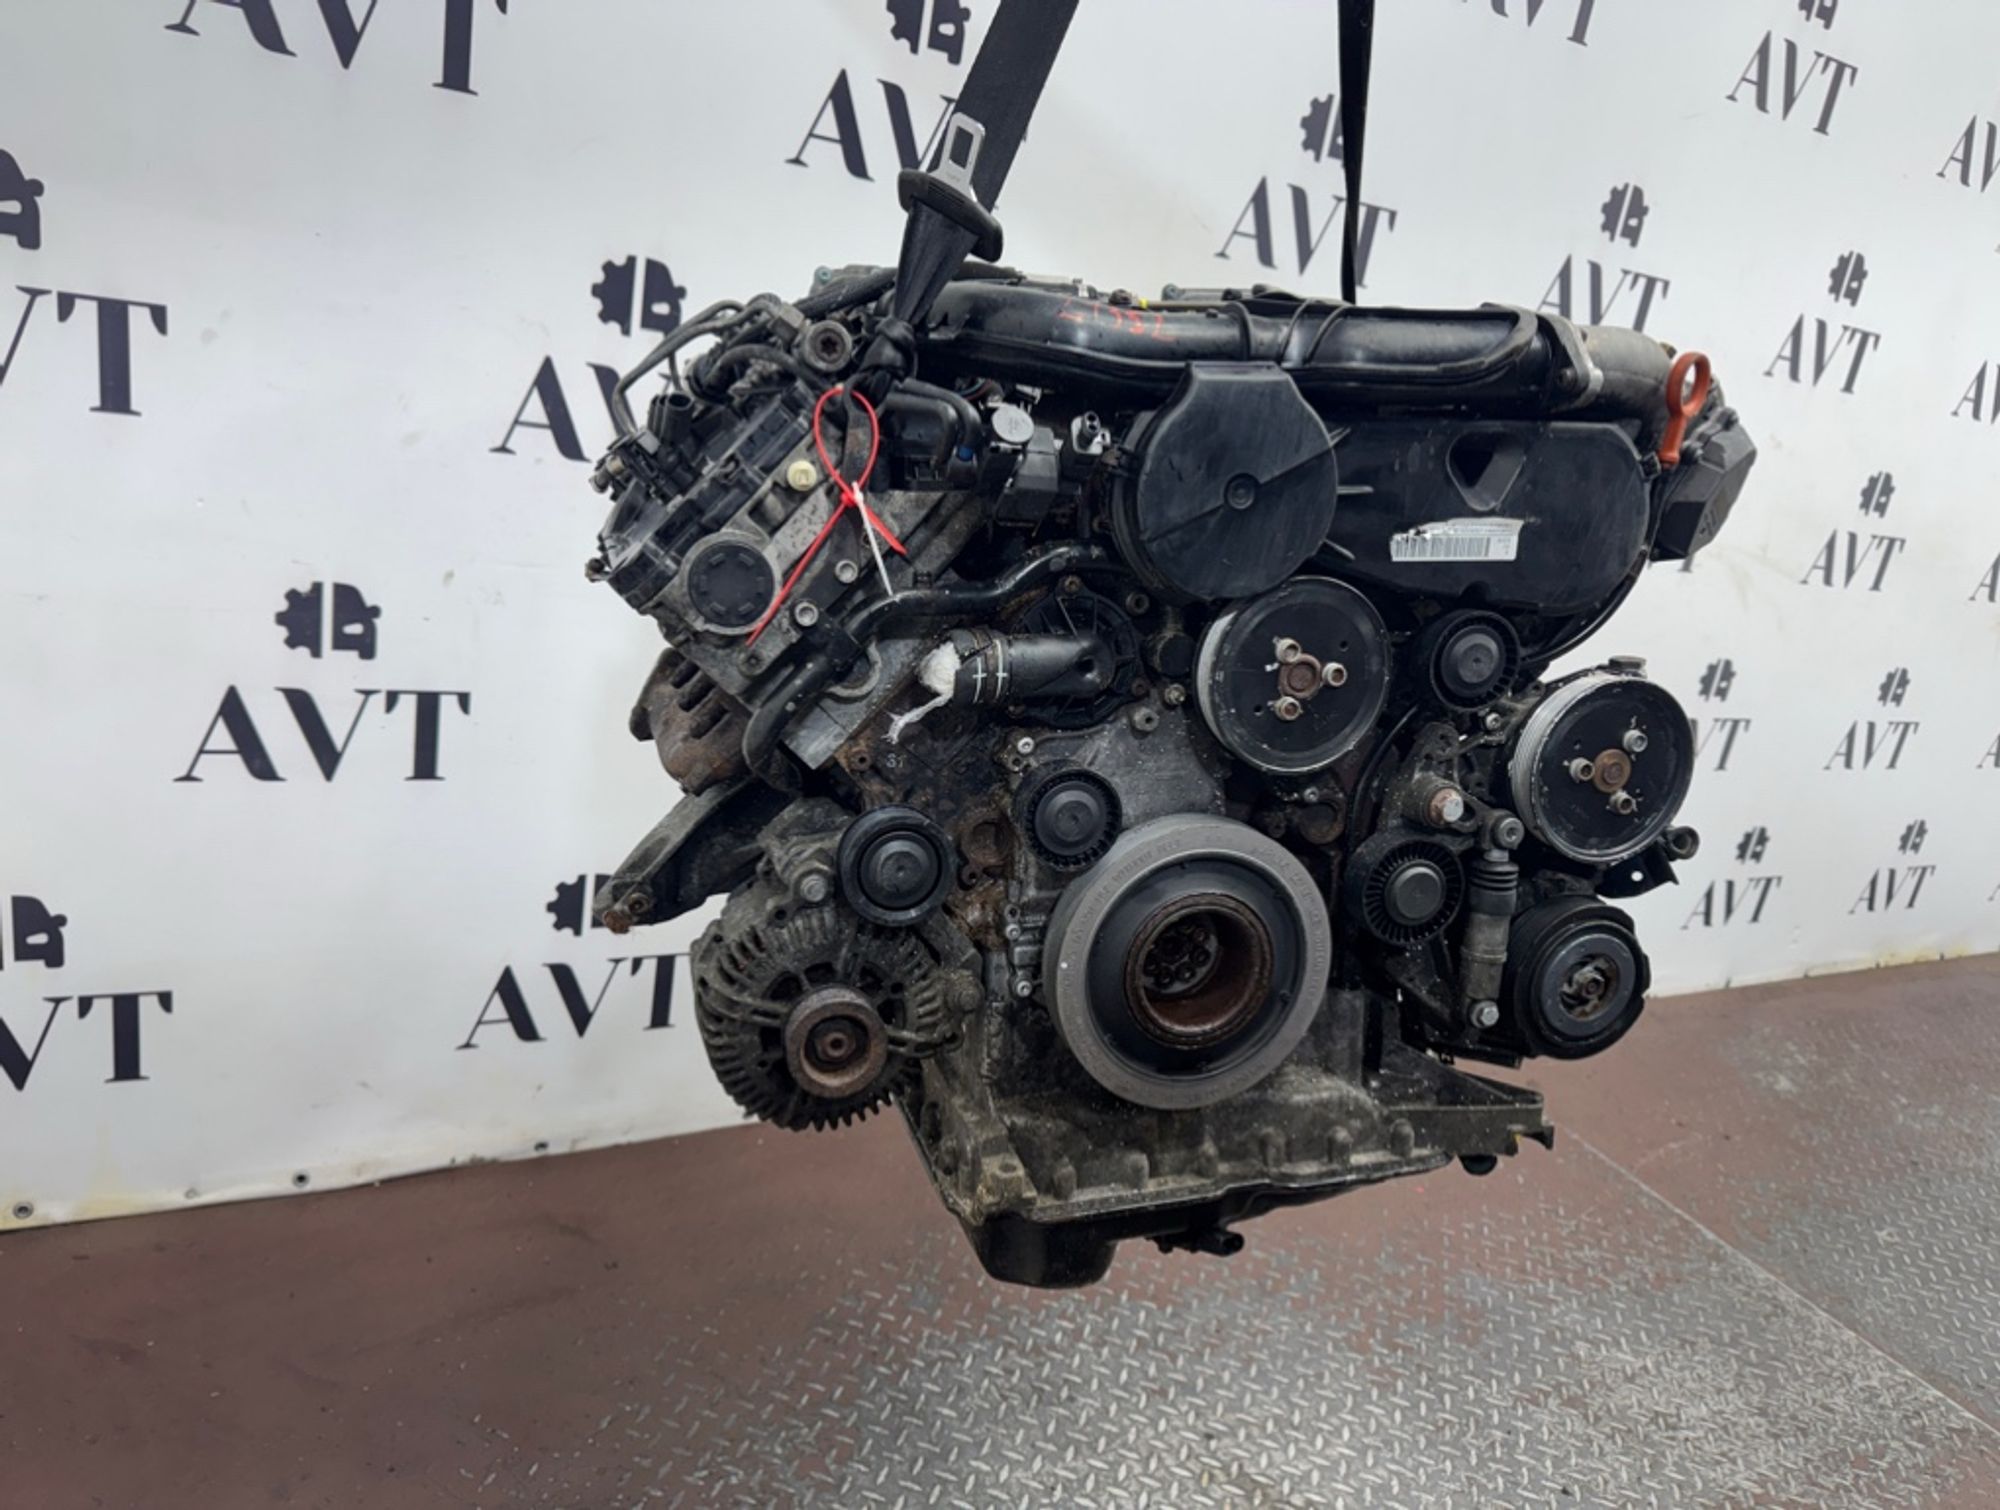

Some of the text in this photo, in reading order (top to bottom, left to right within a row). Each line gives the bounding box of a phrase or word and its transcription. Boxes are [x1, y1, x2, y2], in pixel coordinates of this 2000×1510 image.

[1726, 29, 1858, 137] AVT
[1214, 175, 1397, 287] AVT
[1536, 253, 1670, 332] AVT
[1764, 313, 1880, 394] AVT
[1801, 530, 1906, 592] AVT
[173, 684, 471, 783] AVT
[1822, 720, 1920, 770] AVT
[1680, 875, 1782, 930] AVT
[1848, 865, 1936, 914] AVT
[456, 952, 690, 1050] AVT
